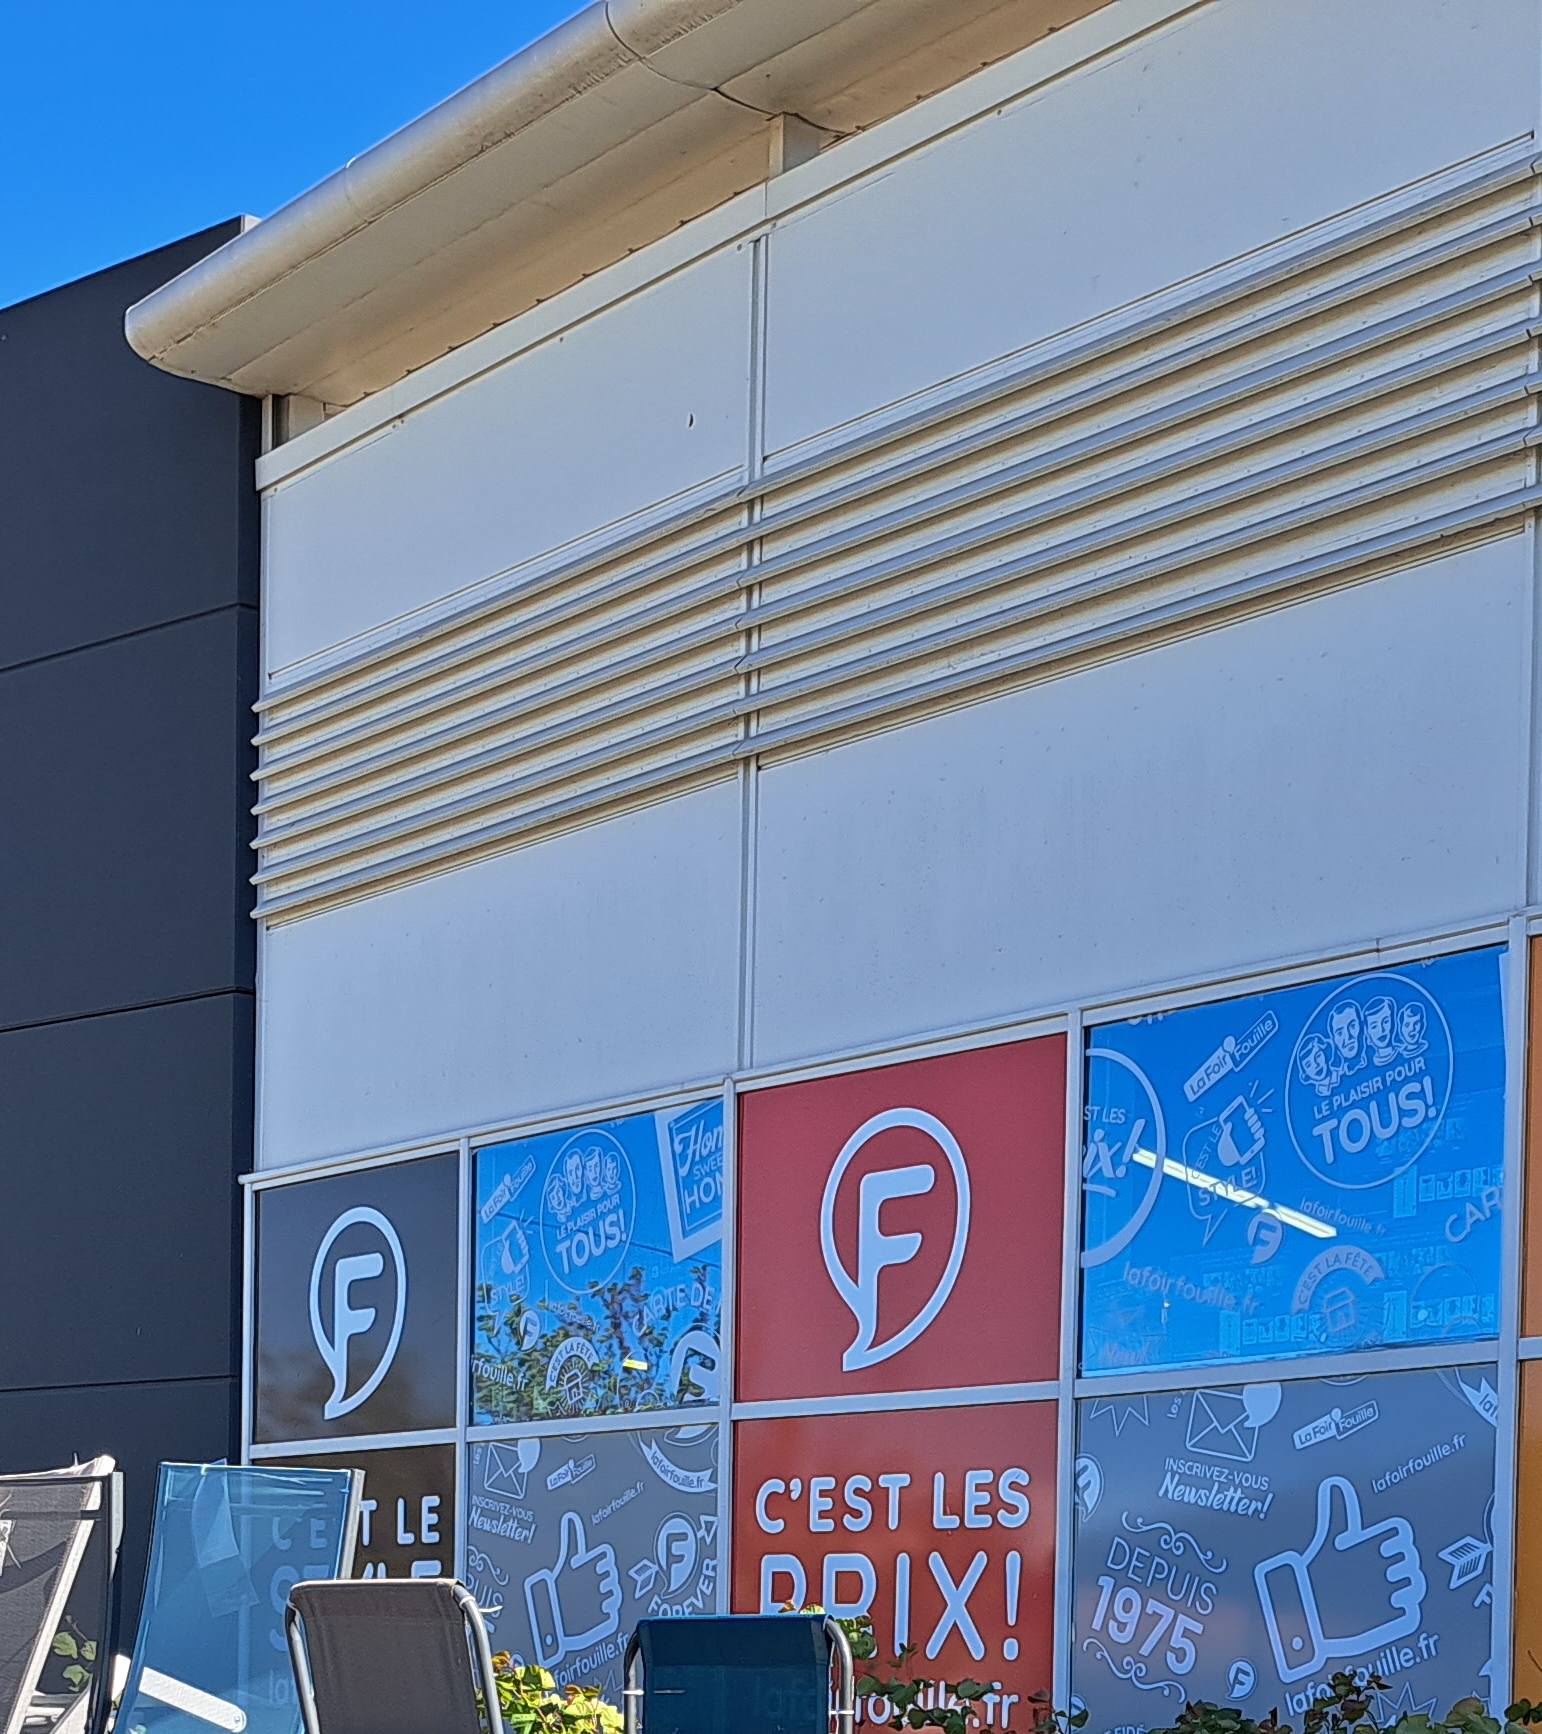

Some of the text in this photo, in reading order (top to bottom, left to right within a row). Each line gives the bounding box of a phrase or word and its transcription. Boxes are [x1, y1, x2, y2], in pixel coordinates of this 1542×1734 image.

[1235, 1019, 1273, 1062] Fouille
[1314, 1057, 1426, 1119] LE PLAISIR POUR
[1103, 1107, 1126, 1124] LES
[1210, 1125, 1221, 1143] LE
[1312, 1076, 1437, 1164] TOUS!
[568, 1207, 596, 1234] PLAISIR
[597, 1194, 620, 1215] POUR
[1300, 1196, 1386, 1236] lafoirfouille.fr
[556, 1208, 627, 1274] TOUS!
[690, 1286, 715, 1307] DE
[1298, 1252, 1373, 1304] C'EST LA FÊTE
[1339, 1407, 1373, 1431] Fouille
[650, 1451, 704, 1489] lafoirfouille.fr
[1164, 1457, 1269, 1490] INSCRIVEZ-VOUS
[1372, 1432, 1466, 1494] lafoirfouille.fr
[590, 1481, 645, 1526] lafoirfouille.fr
[756, 1467, 1030, 1533] C'EST LES
[1158, 1472, 1274, 1520] Newsletter!
[397, 1495, 440, 1545] LE
[468, 1505, 536, 1544] Newsletter!
[1107, 1536, 1217, 1615] DEPUIS
[1092, 1575, 1204, 1675] 1975
